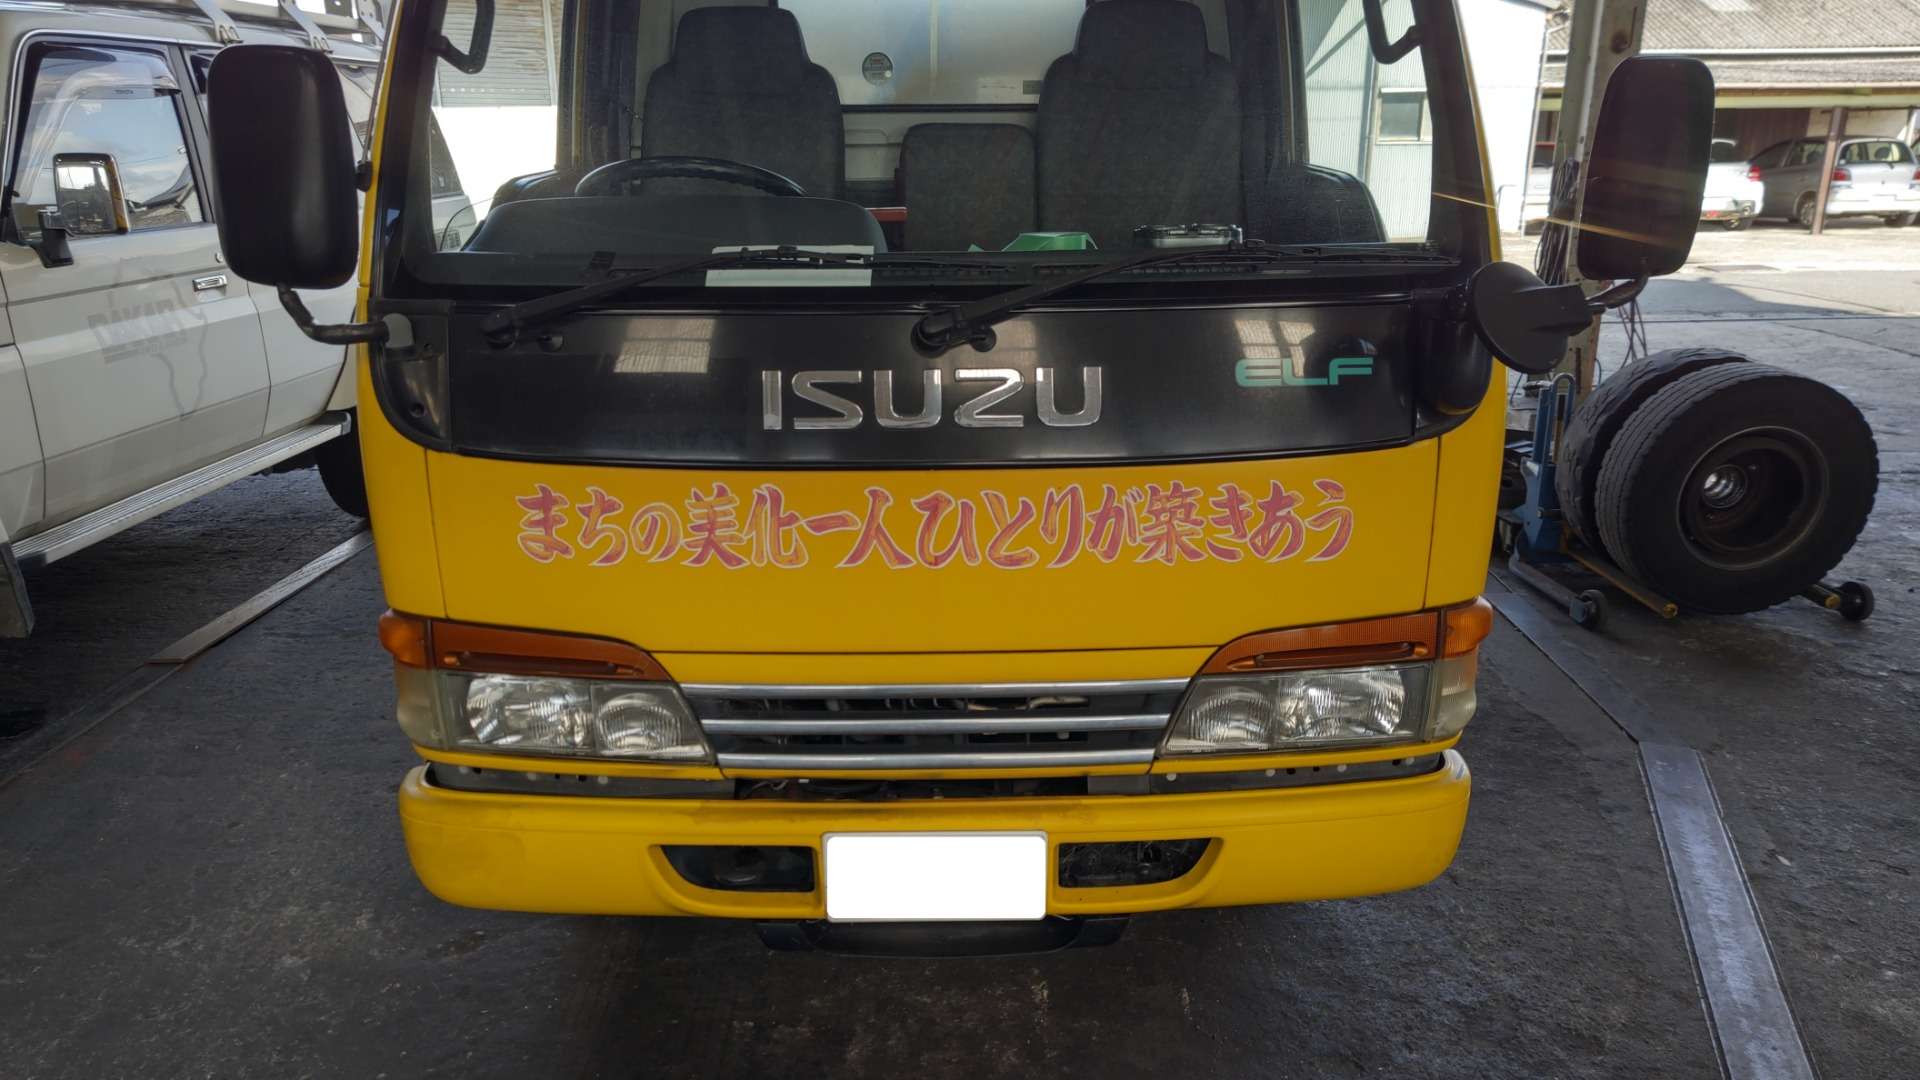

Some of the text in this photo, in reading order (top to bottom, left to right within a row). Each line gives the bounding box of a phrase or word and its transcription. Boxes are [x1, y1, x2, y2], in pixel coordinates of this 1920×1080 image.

[761, 366, 1102, 430] ISUZU
[1235, 357, 1374, 387] ELF
[515, 480, 1354, 569] まちの美化一人ひとりが築きあう
